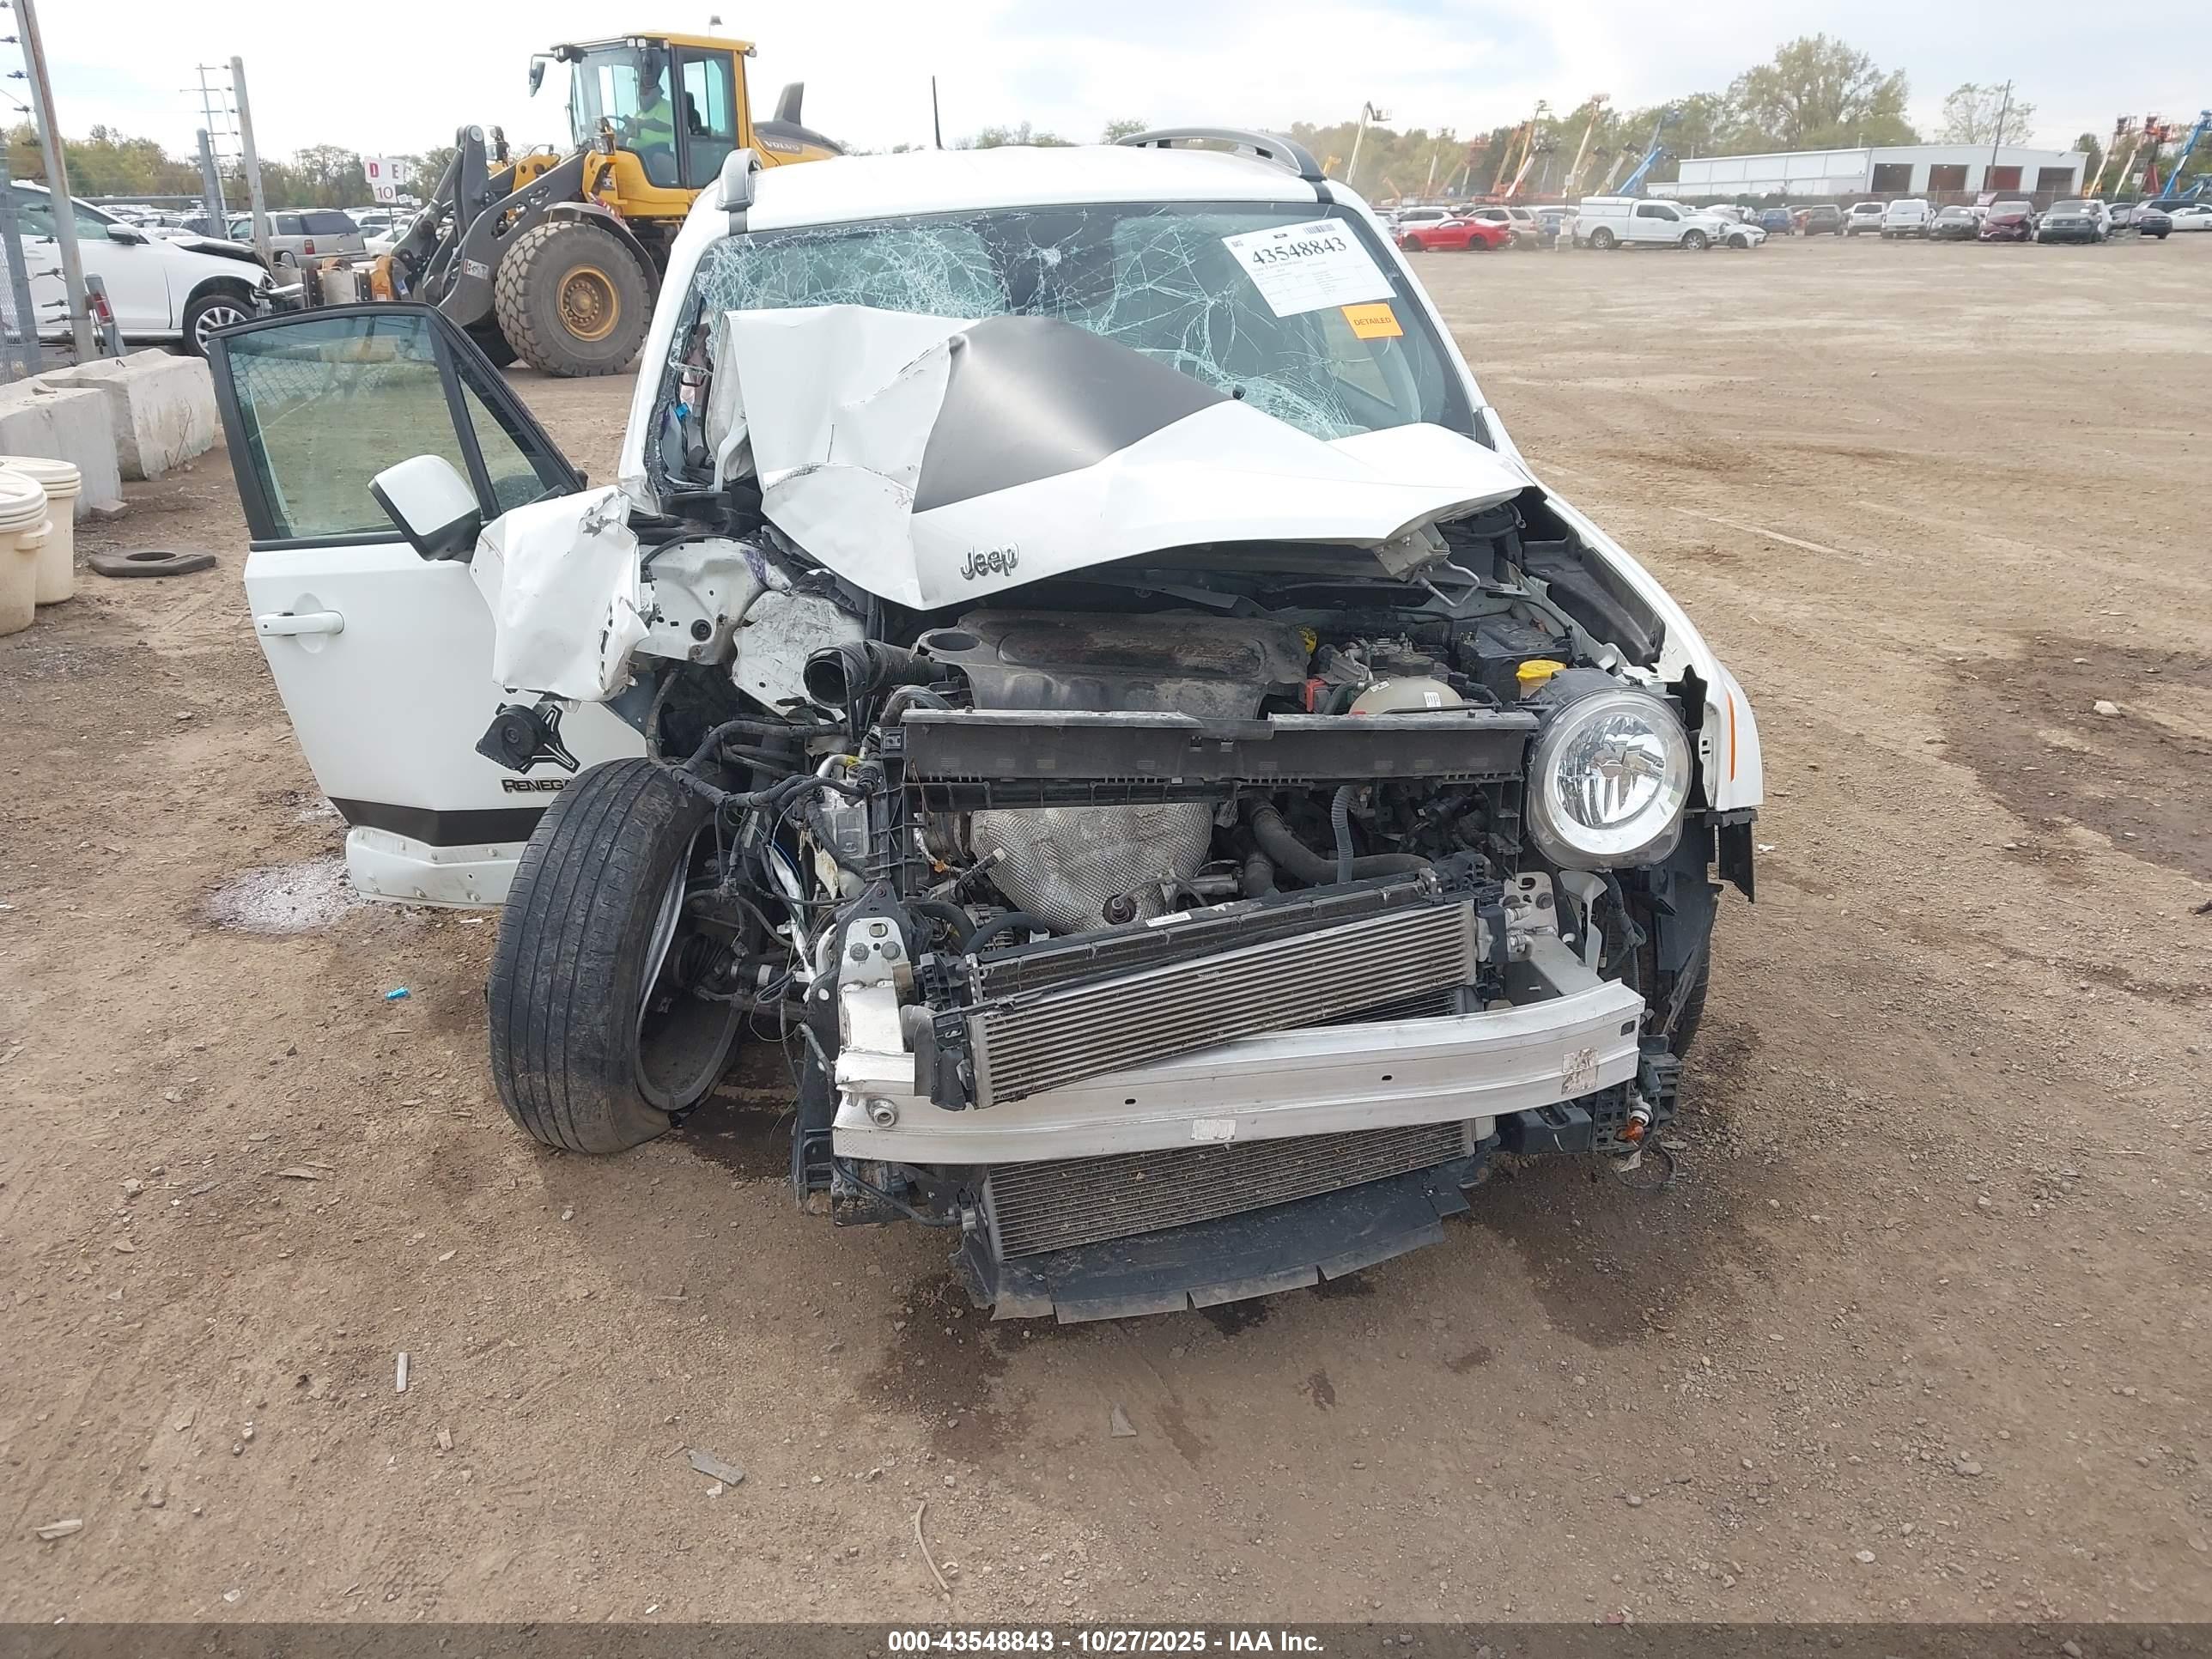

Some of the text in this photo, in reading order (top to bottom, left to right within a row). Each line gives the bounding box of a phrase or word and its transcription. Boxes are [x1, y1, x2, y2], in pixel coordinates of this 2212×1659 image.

[763, 140, 799, 150] VOLVO
[369, 162, 380, 178] D
[392, 163, 399, 179] E
[375, 185, 393, 199] 10
[1253, 236, 1346, 264] 43548843
[1353, 317, 1392, 326] DETAILED
[960, 545, 1019, 580] Jeep
